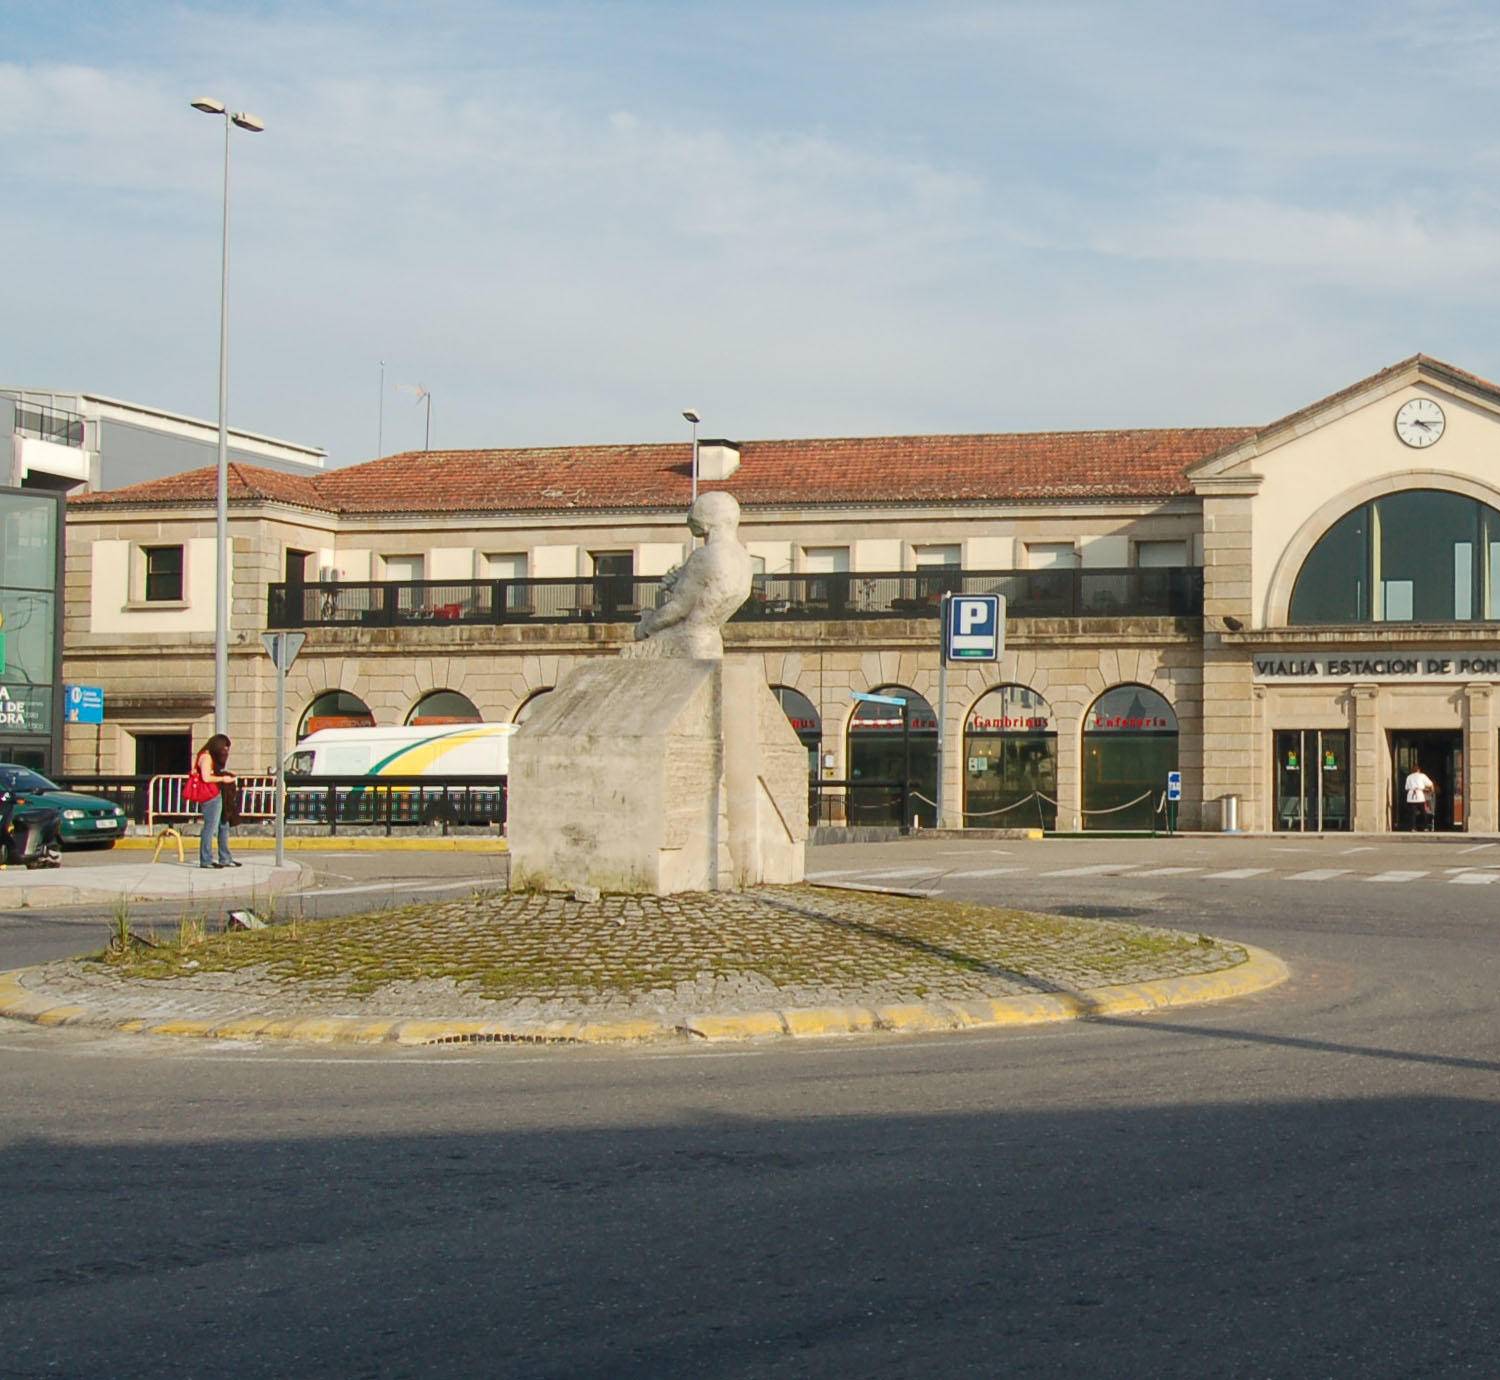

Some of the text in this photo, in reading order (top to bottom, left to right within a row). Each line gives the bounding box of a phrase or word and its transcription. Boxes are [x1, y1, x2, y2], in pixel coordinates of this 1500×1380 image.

[960, 601, 988, 635] P
[1256, 660, 1319, 676] VIALIA
[1327, 660, 1418, 676] ESTACION
[1426, 659, 1451, 674] DE
[7, 701, 25, 713] DE
[973, 714, 1050, 729] Gambrinus
